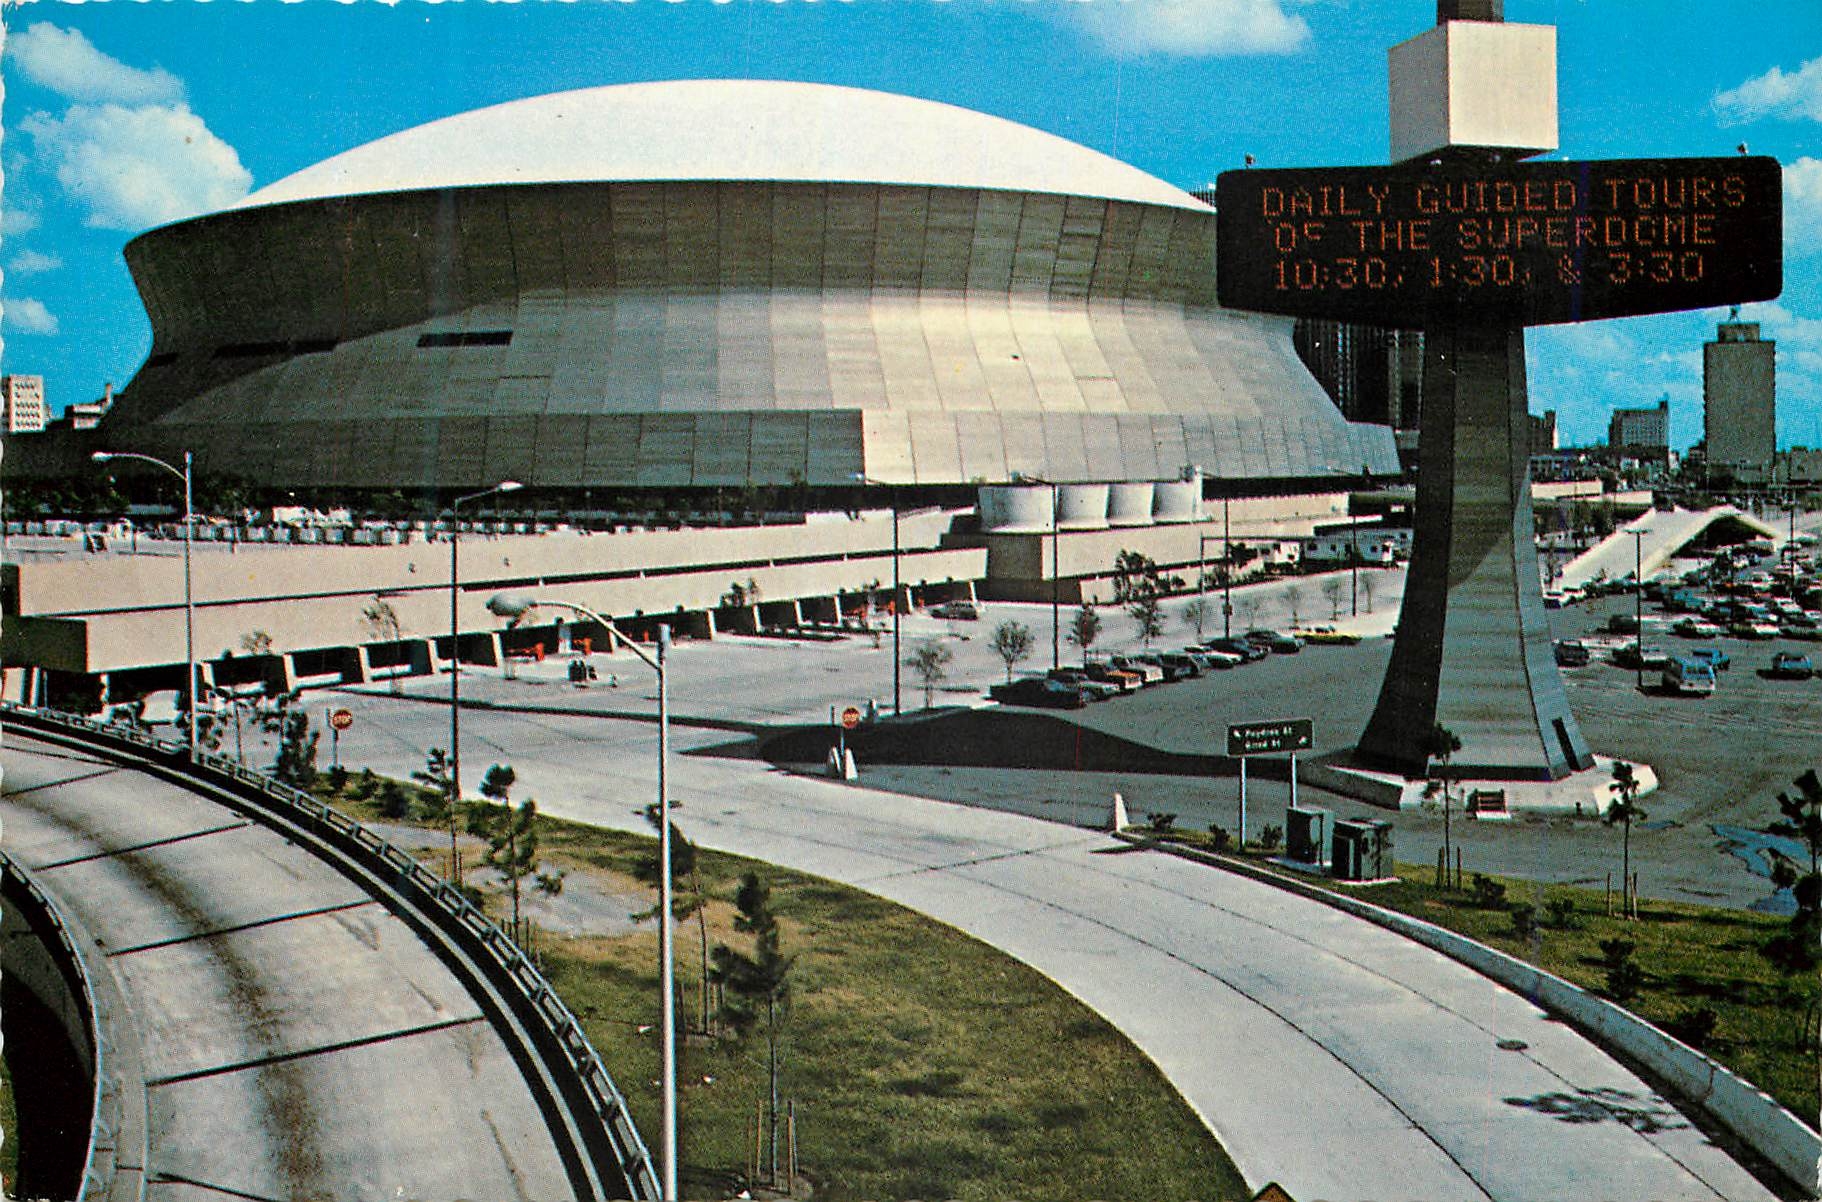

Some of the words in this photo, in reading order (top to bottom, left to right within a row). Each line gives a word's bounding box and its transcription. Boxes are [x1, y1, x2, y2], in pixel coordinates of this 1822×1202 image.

[1263, 183, 1390, 217] DAILY
[1416, 180, 1577, 215] GUIDED
[1604, 175, 1745, 210] TOURS
[1274, 220, 1325, 252] OF
[1352, 219, 1432, 251] THE
[1458, 212, 1716, 250] SUPERDOME
[1274, 257, 1404, 290] 10:30,
[1430, 253, 1531, 289] 1:30,
[1557, 253, 1582, 285] &
[1608, 251, 1704, 286] 3:30
